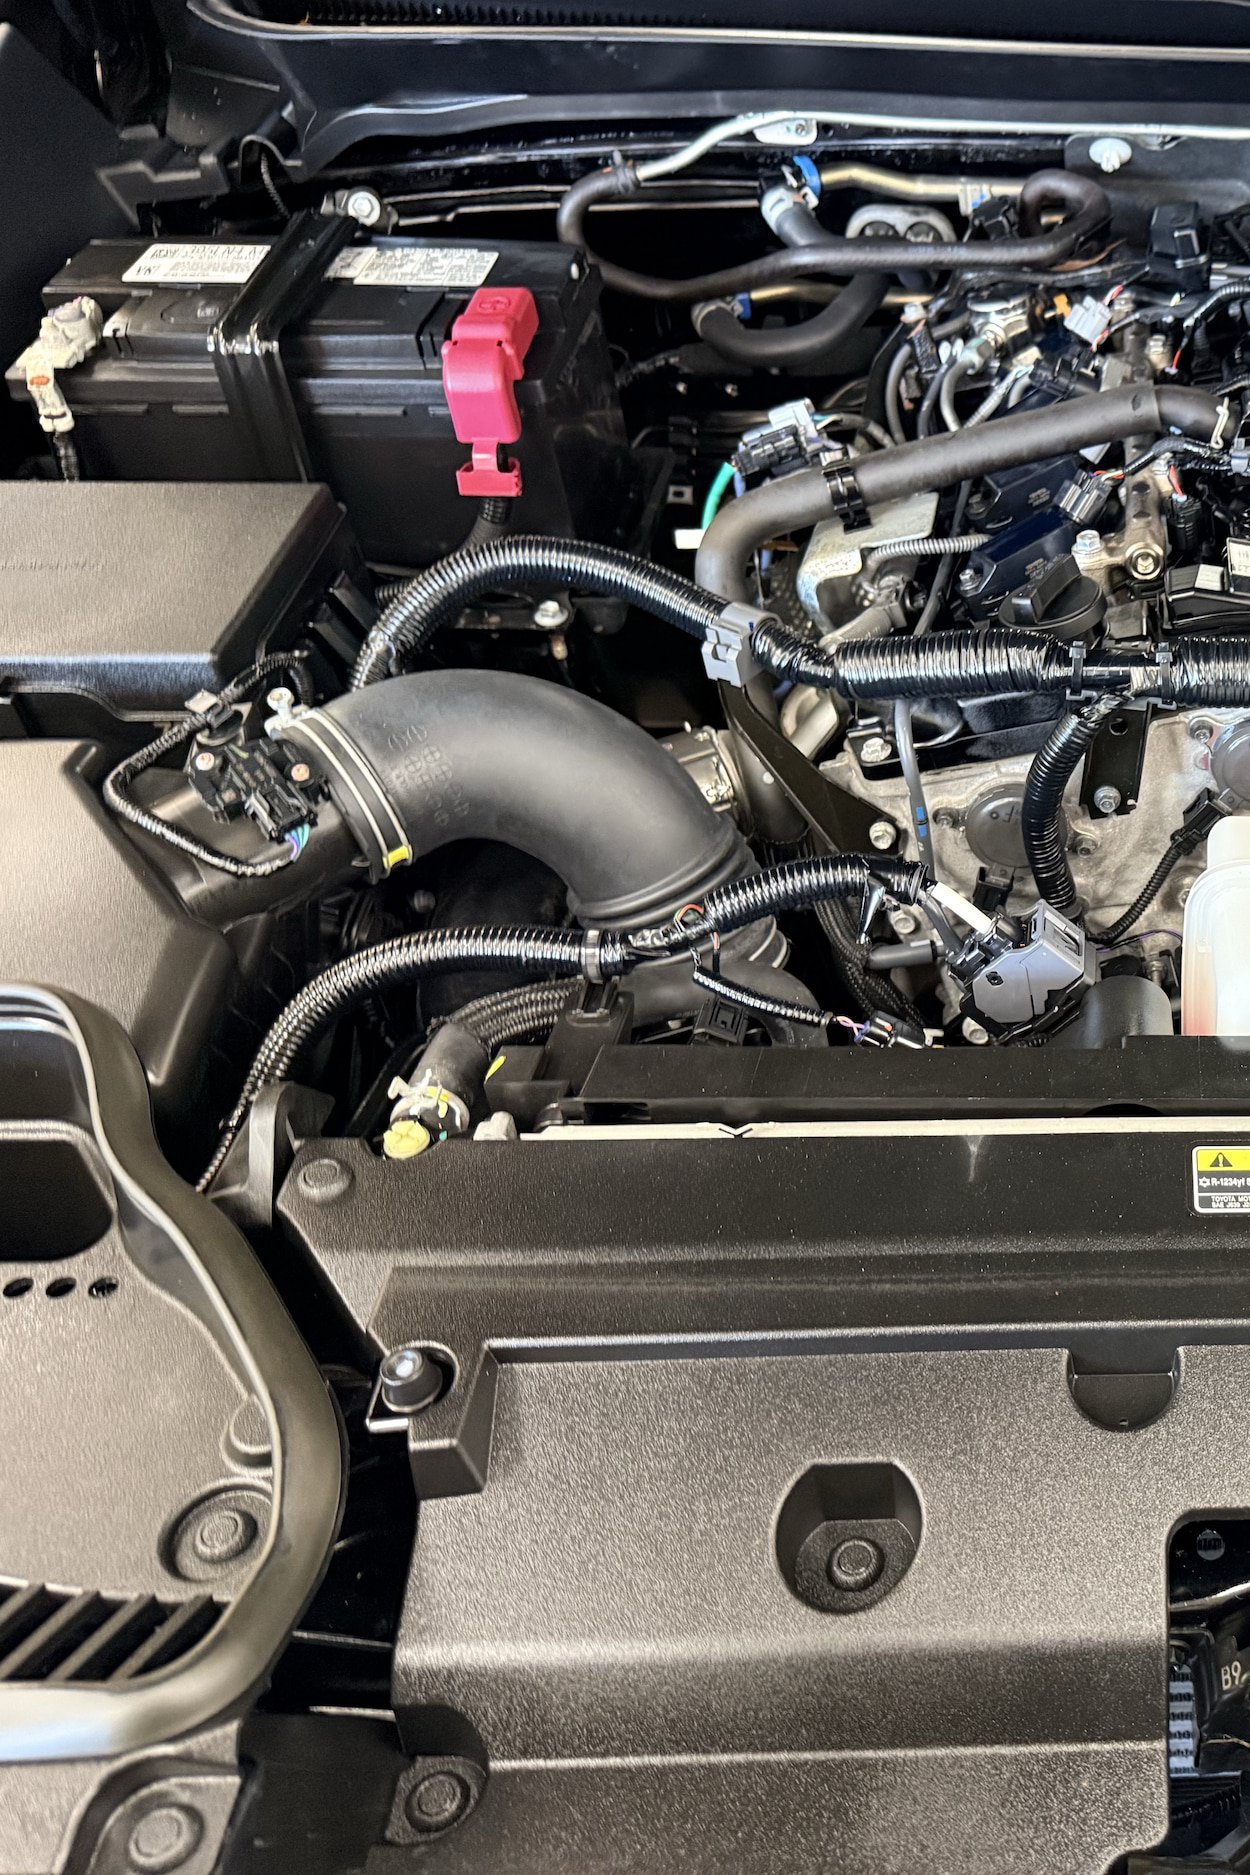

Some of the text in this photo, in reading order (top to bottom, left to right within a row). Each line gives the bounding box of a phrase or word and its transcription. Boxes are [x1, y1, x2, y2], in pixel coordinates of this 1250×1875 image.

[1211, 1177, 1245, 1188] R-1234yf
[1211, 1195, 1237, 1203] TOYOTA
[1221, 1661, 1242, 1690] B9
